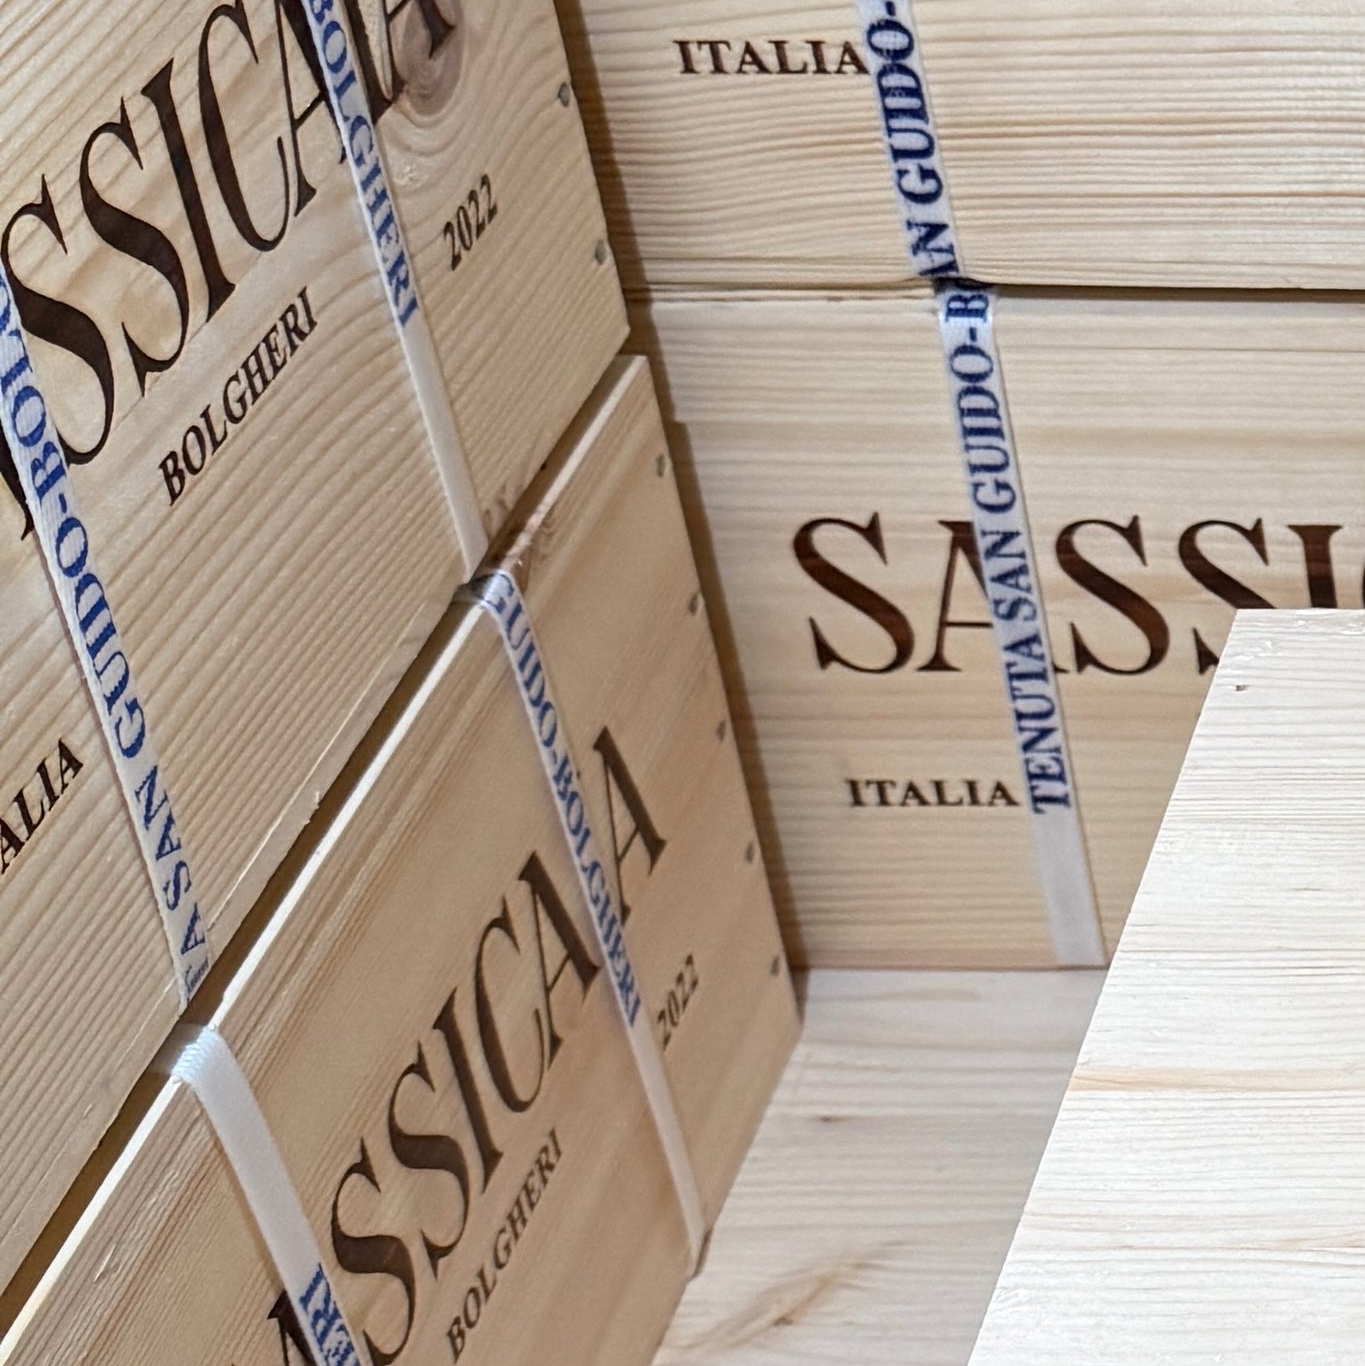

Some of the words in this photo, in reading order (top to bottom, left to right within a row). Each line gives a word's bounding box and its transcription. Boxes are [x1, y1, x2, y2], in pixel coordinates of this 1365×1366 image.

[673, 40, 869, 75] ITALIA
[443, 173, 498, 271] 2022
[157, 285, 318, 506] BOLGHERI
[980, 529, 1040, 621] SAN
[1003, 635, 1073, 813] TENUTA
[141, 765, 192, 911] SAN
[847, 778, 1018, 808] ITALIA
[655, 954, 702, 1047] 2022
[445, 1128, 563, 1365] BOLGHERI
